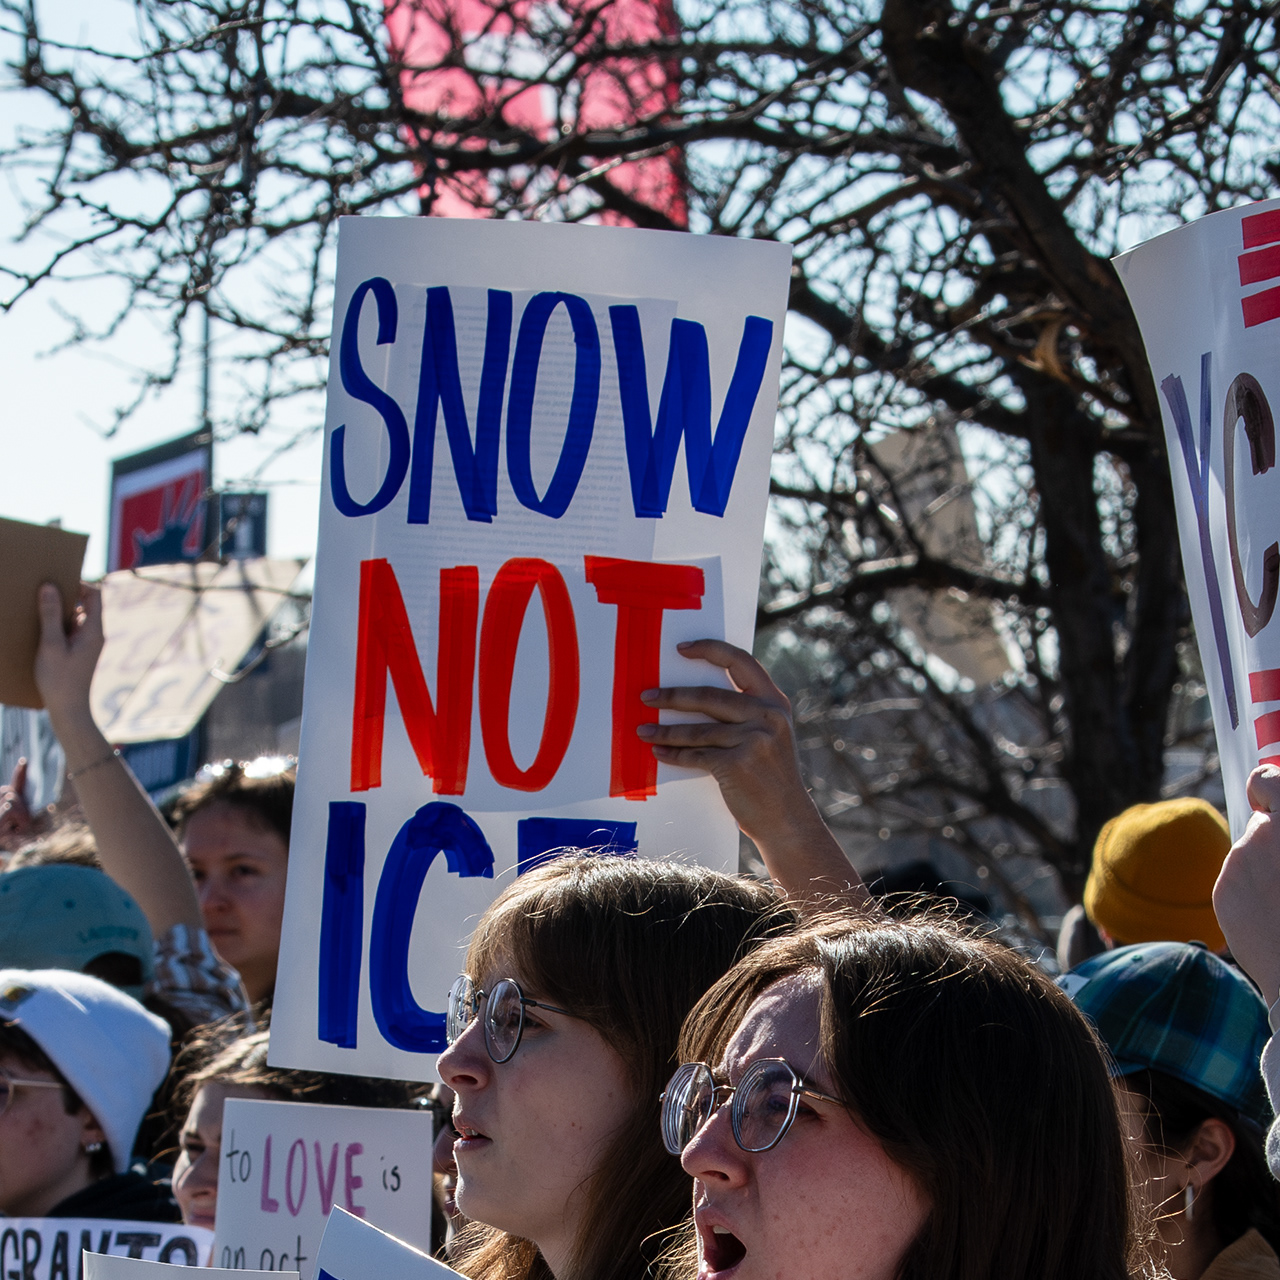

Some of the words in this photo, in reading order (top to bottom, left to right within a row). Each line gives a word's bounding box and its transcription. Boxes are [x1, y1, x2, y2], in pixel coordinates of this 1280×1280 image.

[331, 276, 773, 524] SNOW
[350, 556, 705, 801] NOT
[318, 801, 638, 1054] IC
[226, 1128, 251, 1183] to
[261, 1133, 366, 1218] LOVE
[380, 1155, 401, 1192] is
